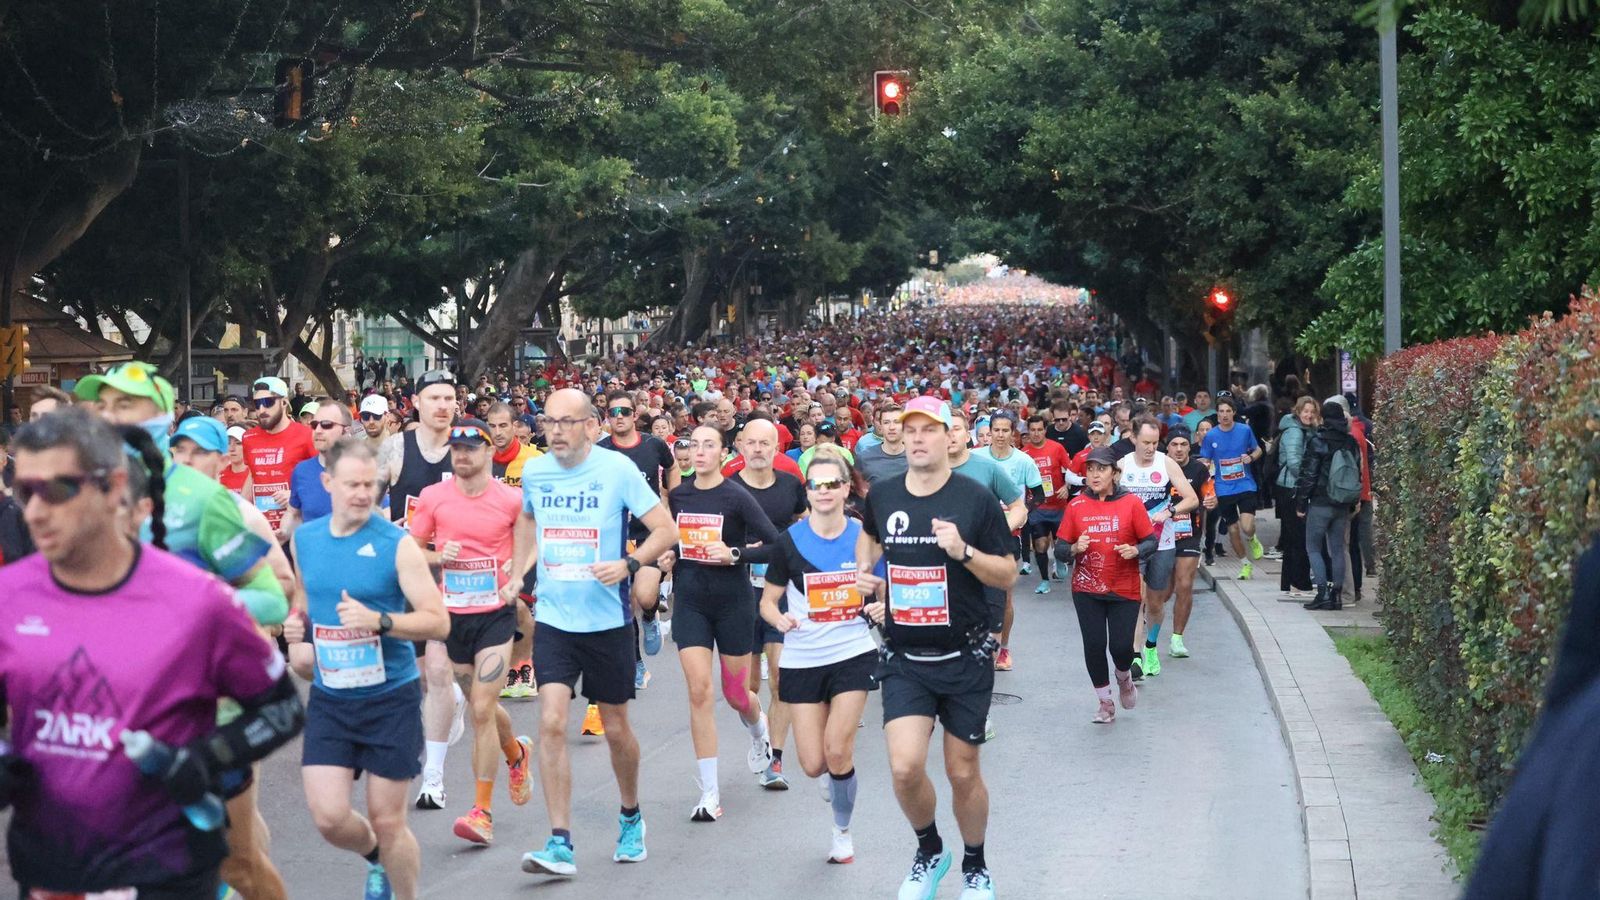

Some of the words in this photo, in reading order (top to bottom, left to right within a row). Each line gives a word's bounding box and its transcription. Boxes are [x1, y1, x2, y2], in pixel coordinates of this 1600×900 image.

[22, 373, 48, 383] ¡HOLA!
[541, 491, 599, 512] nerja
[690, 517, 719, 526] GENERALI
[557, 529, 595, 538] GENERALI
[895, 536, 918, 544] MUST
[454, 559, 492, 569] GENERALI
[900, 570, 941, 580] GENERALI
[821, 590, 849, 602] 7196
[902, 587, 930, 600] 5929
